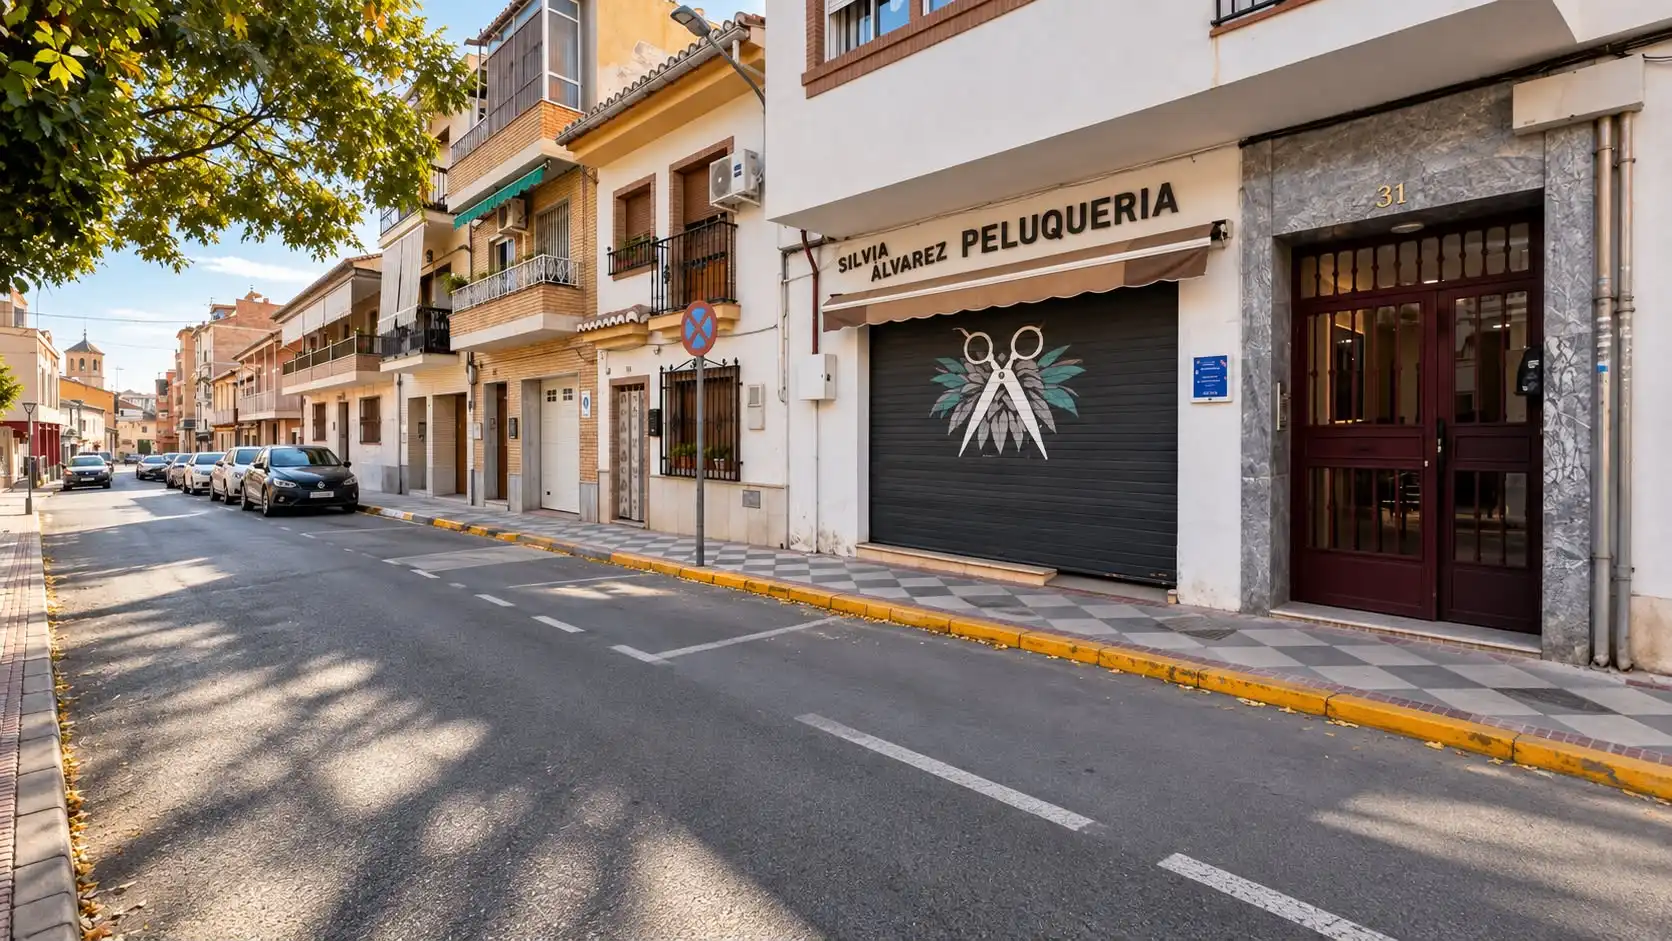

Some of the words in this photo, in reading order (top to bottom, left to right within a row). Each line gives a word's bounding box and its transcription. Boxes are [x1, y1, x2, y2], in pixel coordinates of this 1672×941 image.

[1376, 183, 1407, 208] 31
[962, 182, 1179, 258] PELUQUERIA
[838, 242, 889, 273] SILVIA
